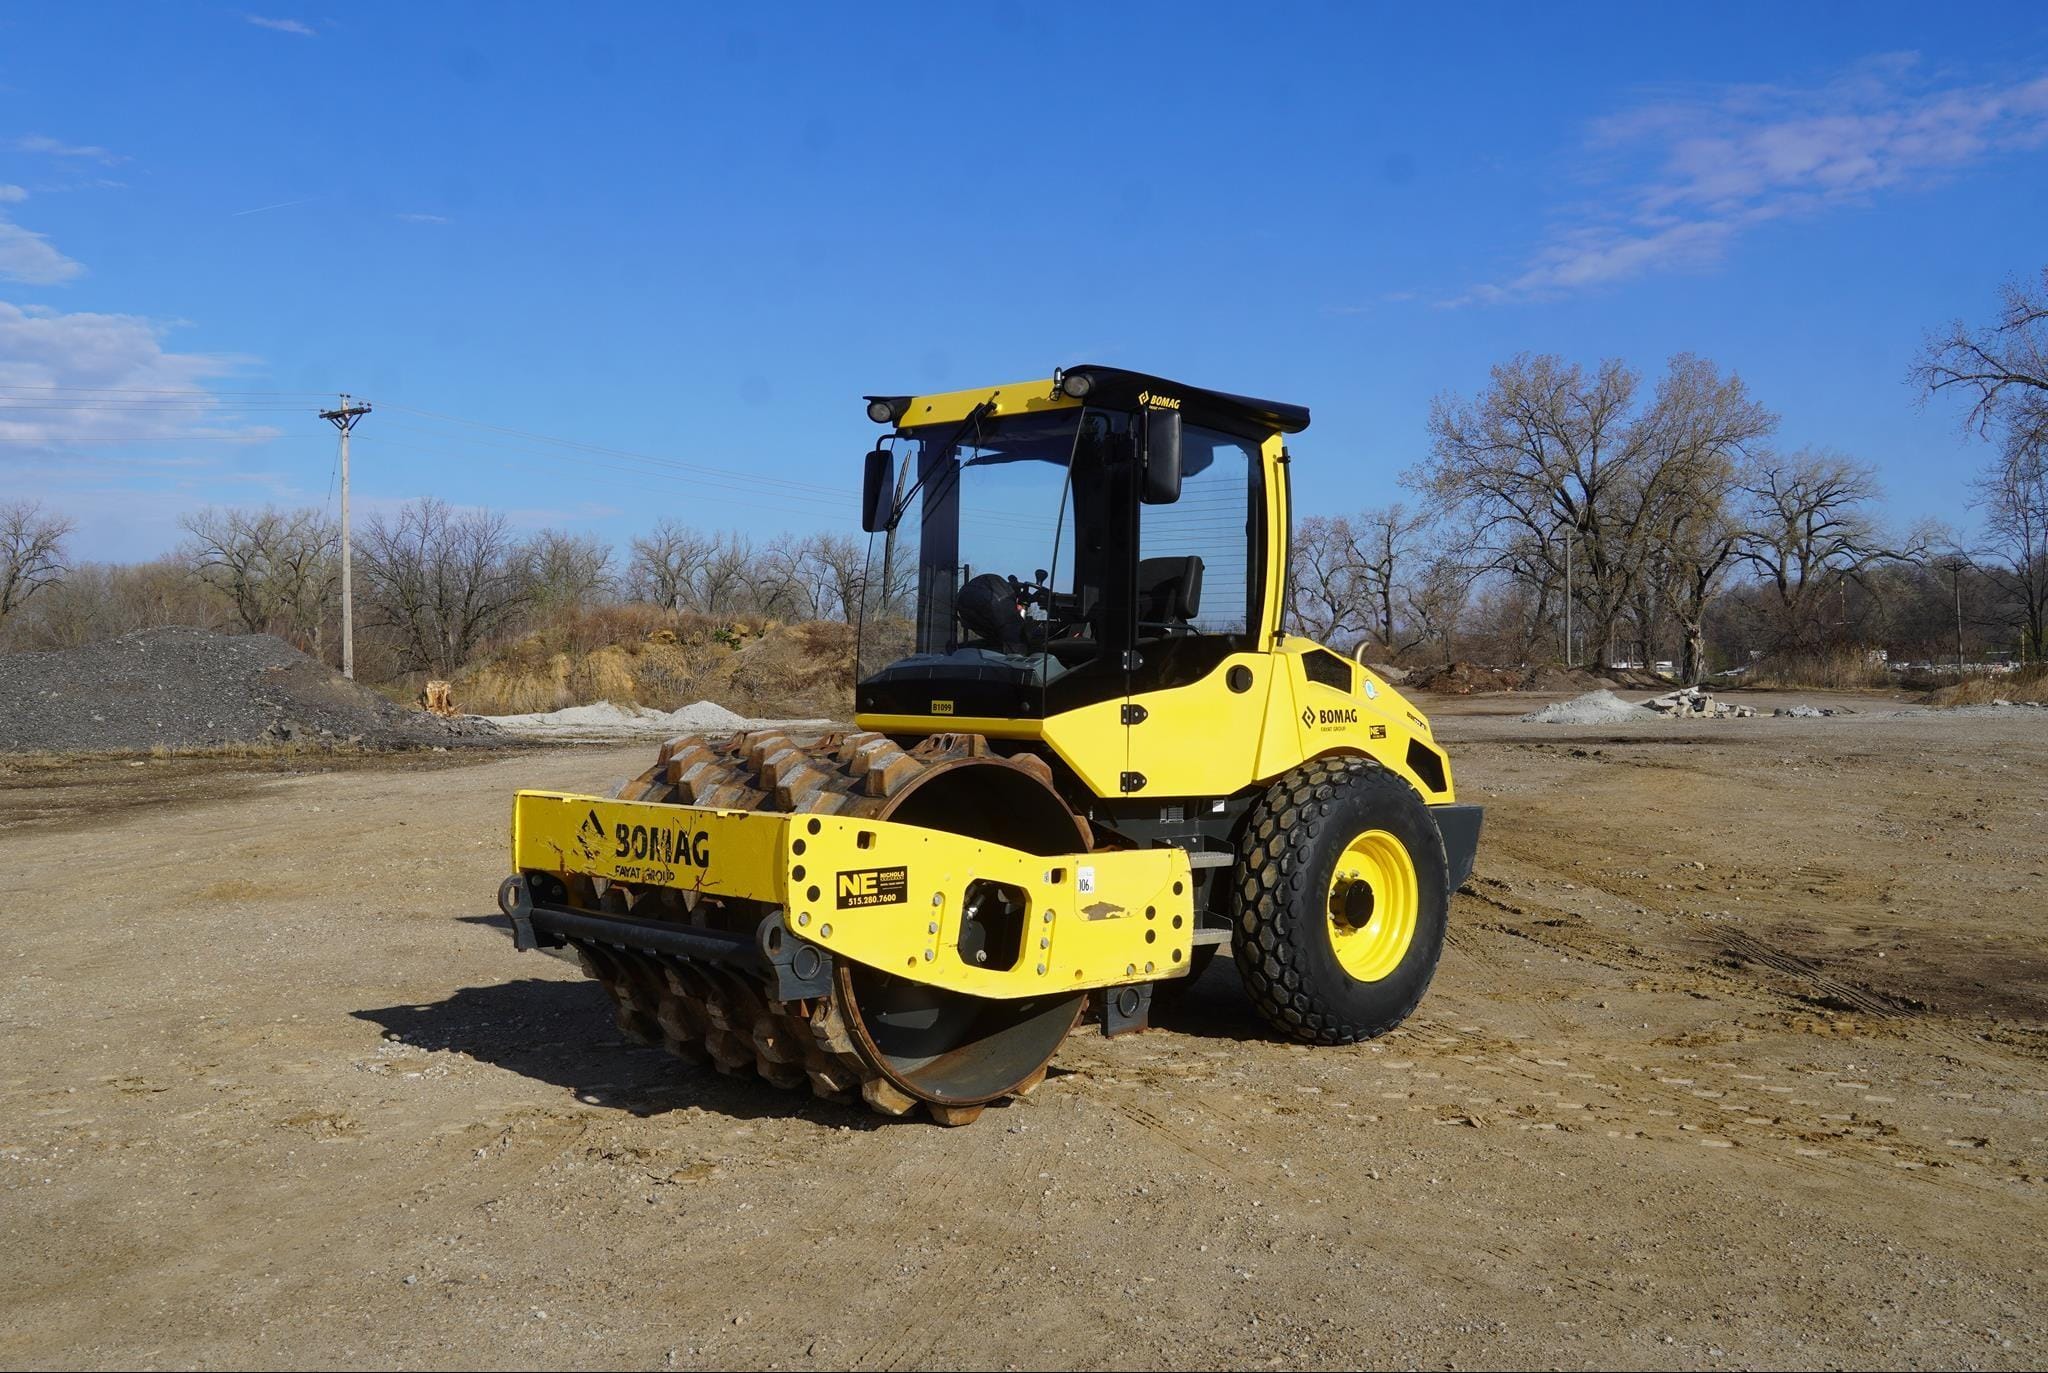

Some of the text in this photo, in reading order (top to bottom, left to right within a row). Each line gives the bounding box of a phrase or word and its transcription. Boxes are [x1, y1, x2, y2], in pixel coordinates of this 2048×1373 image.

[1150, 395, 1181, 409] BOMAG
[1319, 709, 1358, 724] BOMAG
[616, 823, 710, 868] BOMAG
[615, 865, 641, 879] FAYAT
[839, 872, 878, 897] NE
[848, 893, 897, 906] 515.280.7600
